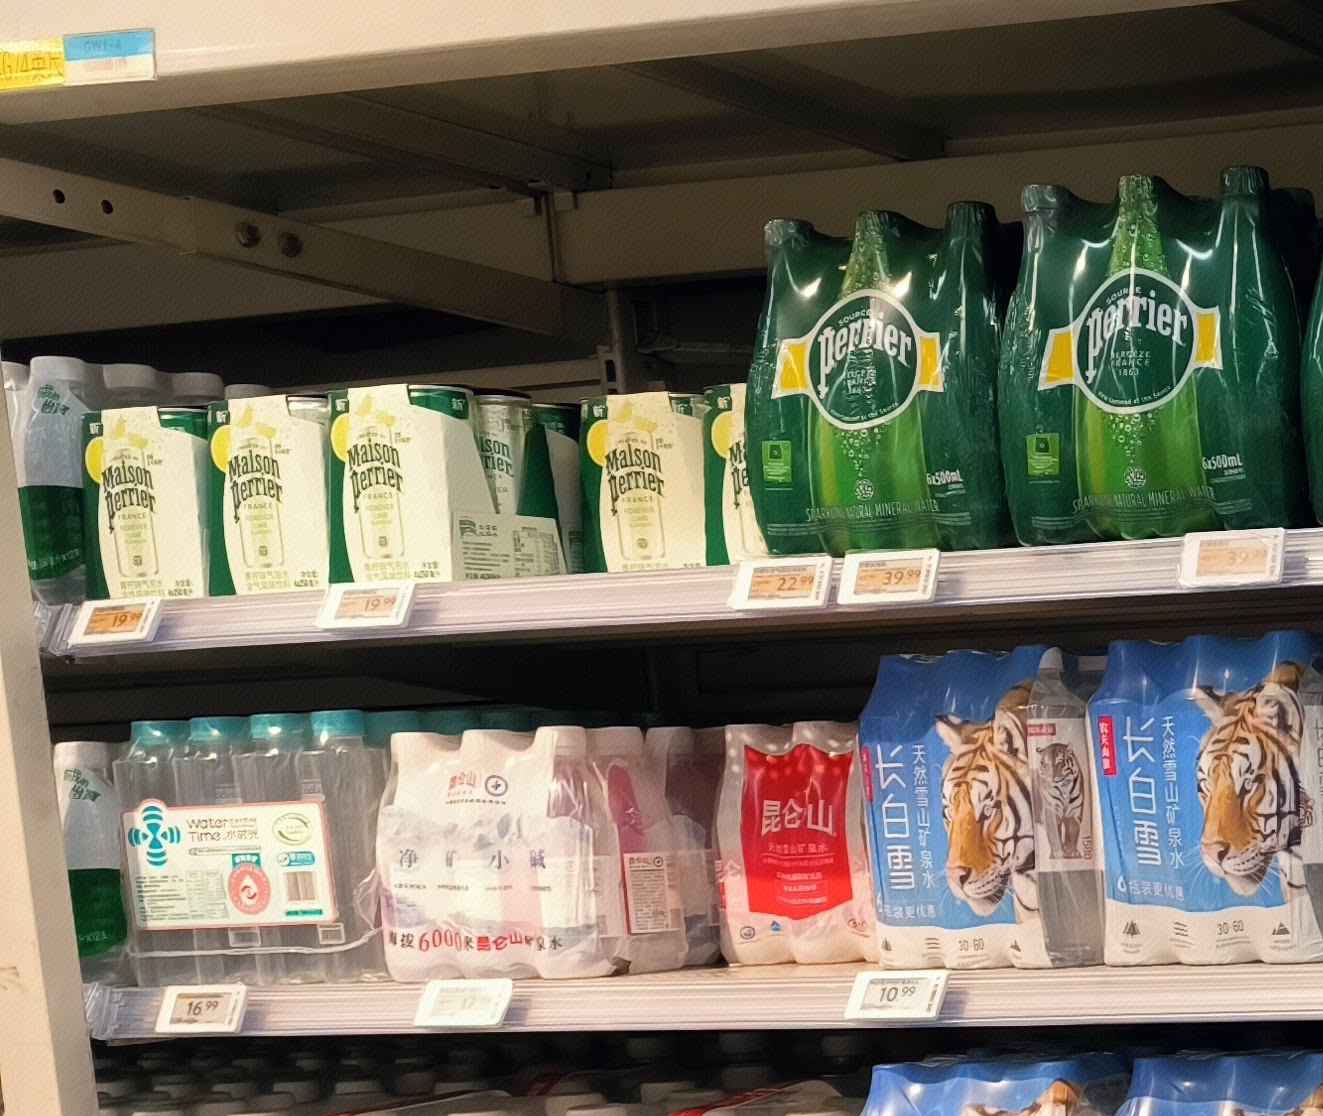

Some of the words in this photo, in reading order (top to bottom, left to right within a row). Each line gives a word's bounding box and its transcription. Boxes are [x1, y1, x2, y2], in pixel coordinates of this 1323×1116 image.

[817, 310, 912, 400] Perrier
[1086, 290, 1189, 384] Perrier
[227, 449, 281, 483] Maison
[346, 438, 401, 472] Maison
[604, 443, 663, 476] Maison
[101, 459, 154, 494] Maison
[1162, 715, 1186, 870] 天然雪山矿泉水
[760, 798, 835, 837] 昆仑山
[875, 743, 916, 890] 长白雪
